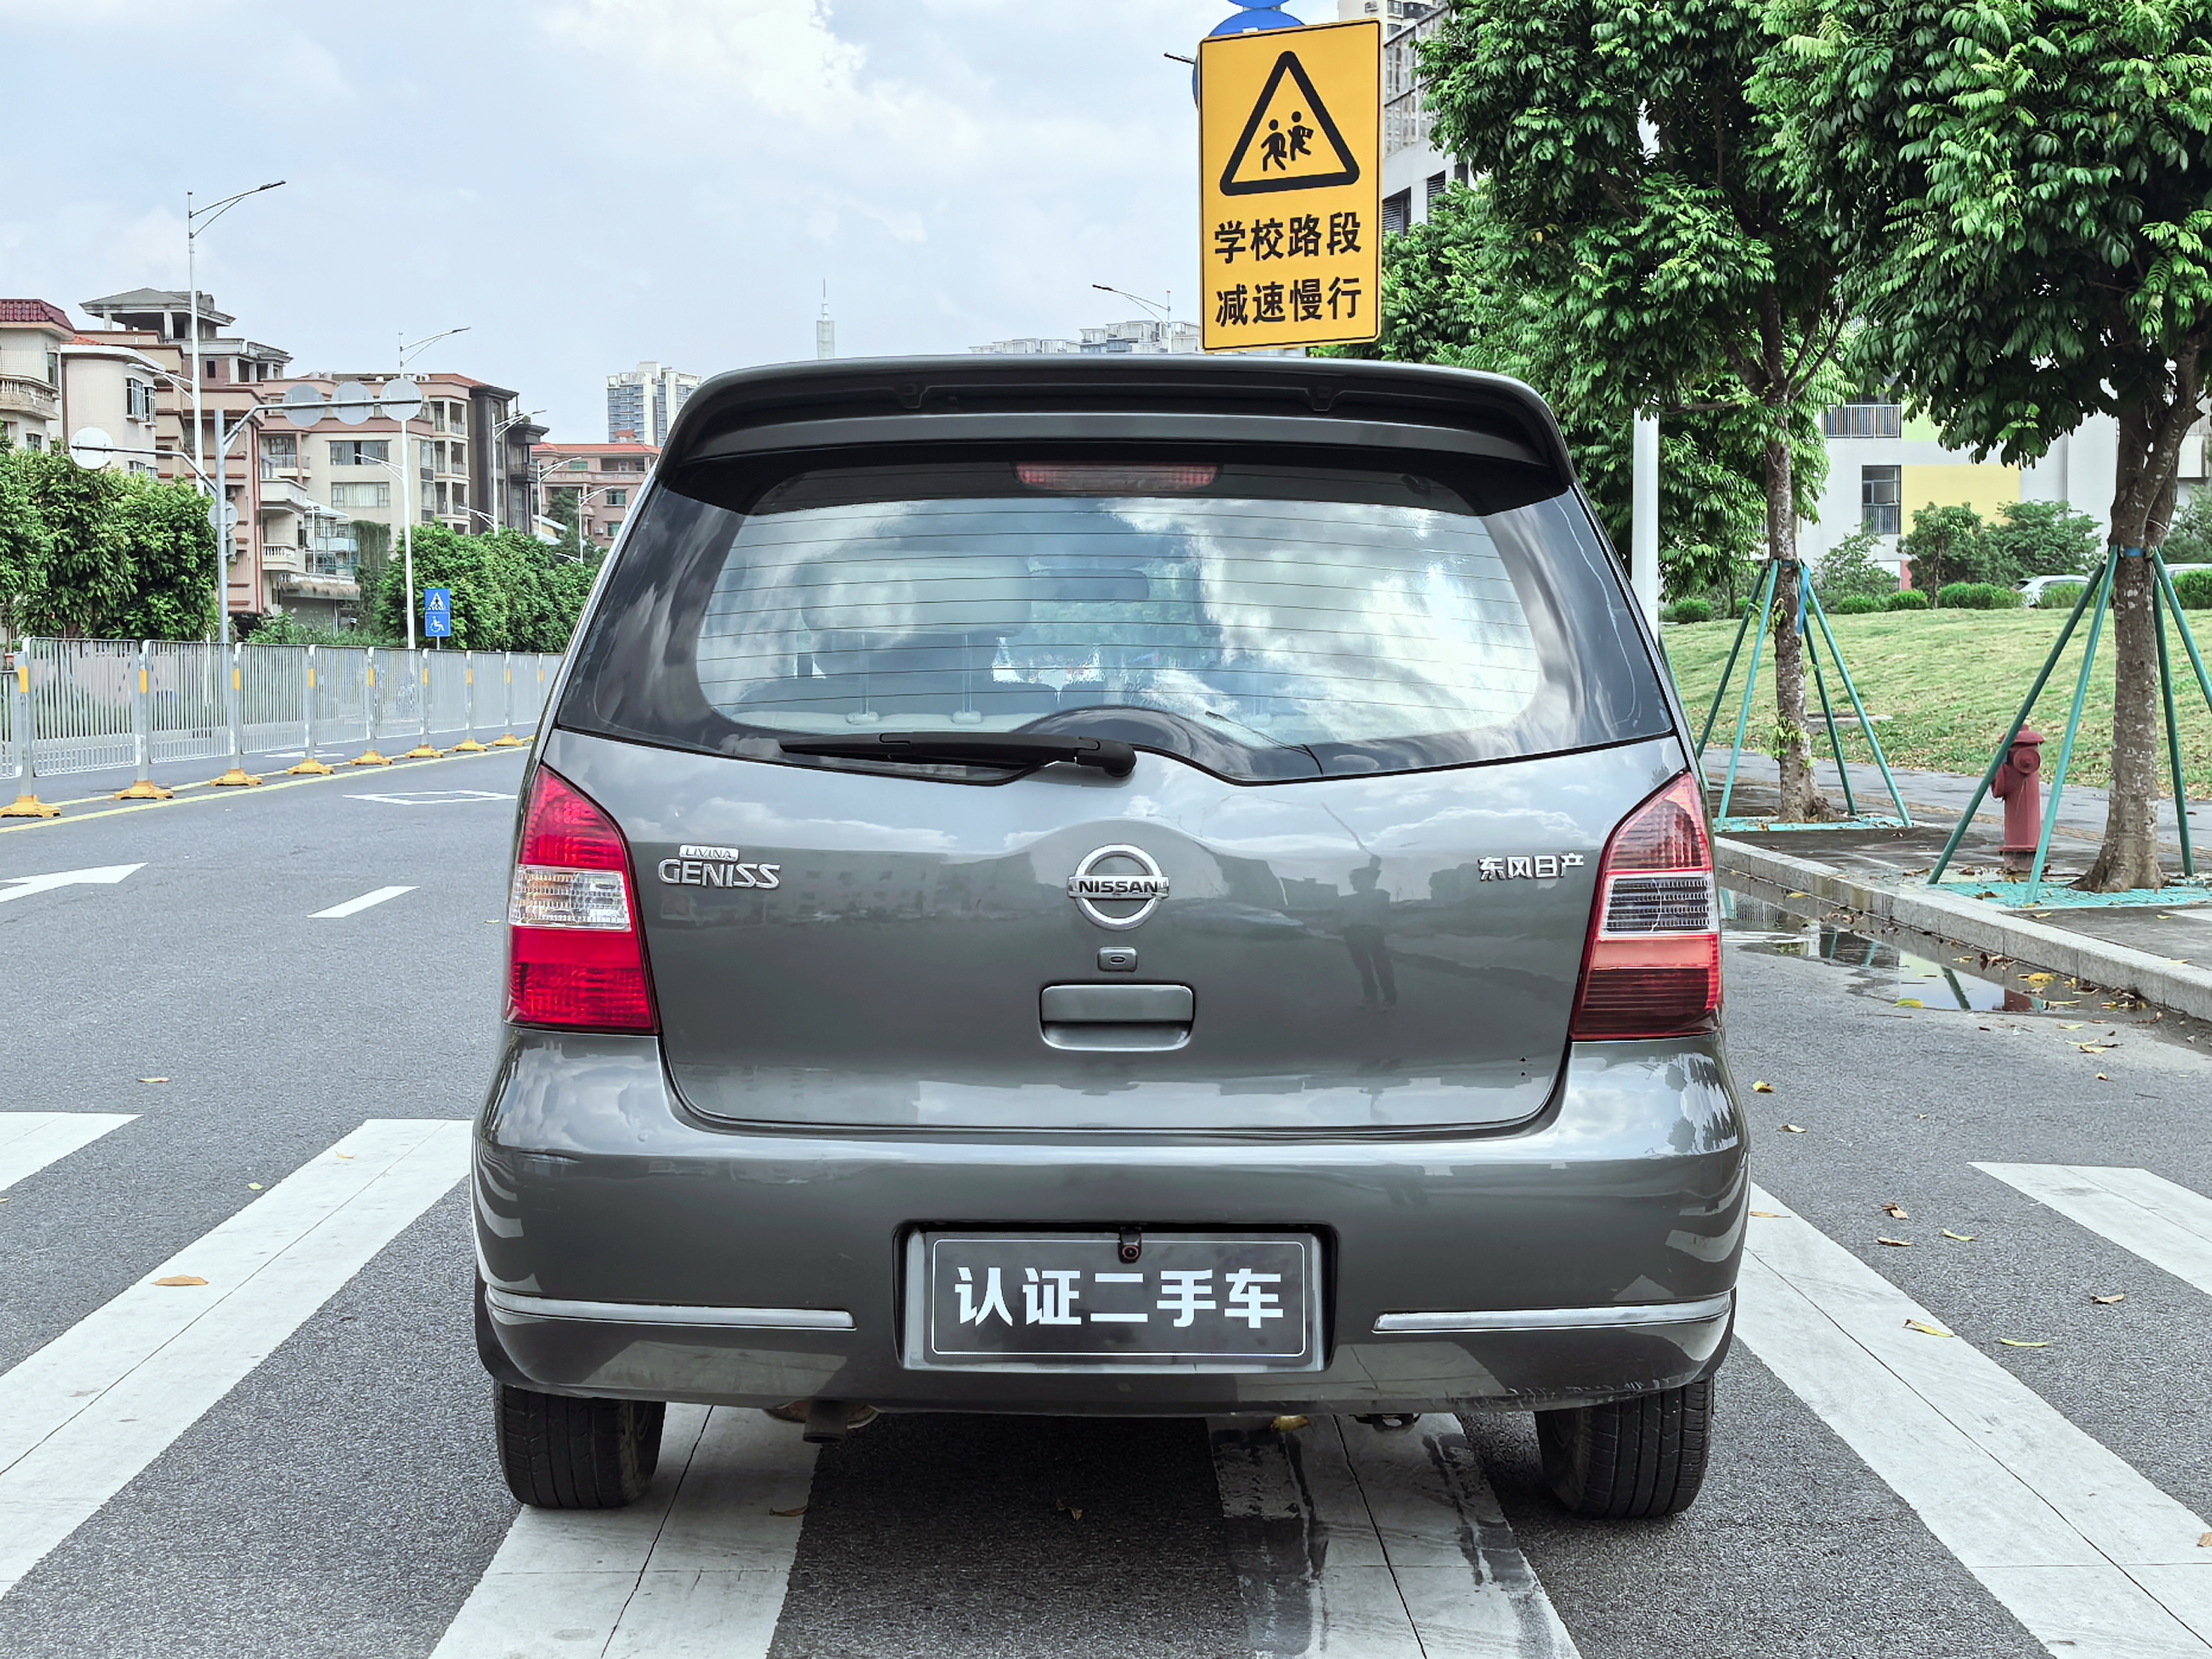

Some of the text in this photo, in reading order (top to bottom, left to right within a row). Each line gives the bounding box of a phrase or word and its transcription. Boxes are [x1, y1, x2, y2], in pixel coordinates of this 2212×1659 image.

[1214, 212, 1362, 264] 学校路段
[1215, 276, 1362, 327] 减速慢行
[685, 847, 732, 859] LIVINA
[1478, 852, 1584, 881] 东风日产
[658, 858, 781, 889] GENISS
[1079, 880, 1158, 893] NISSAN
[954, 1266, 1285, 1328] 认证二手车
